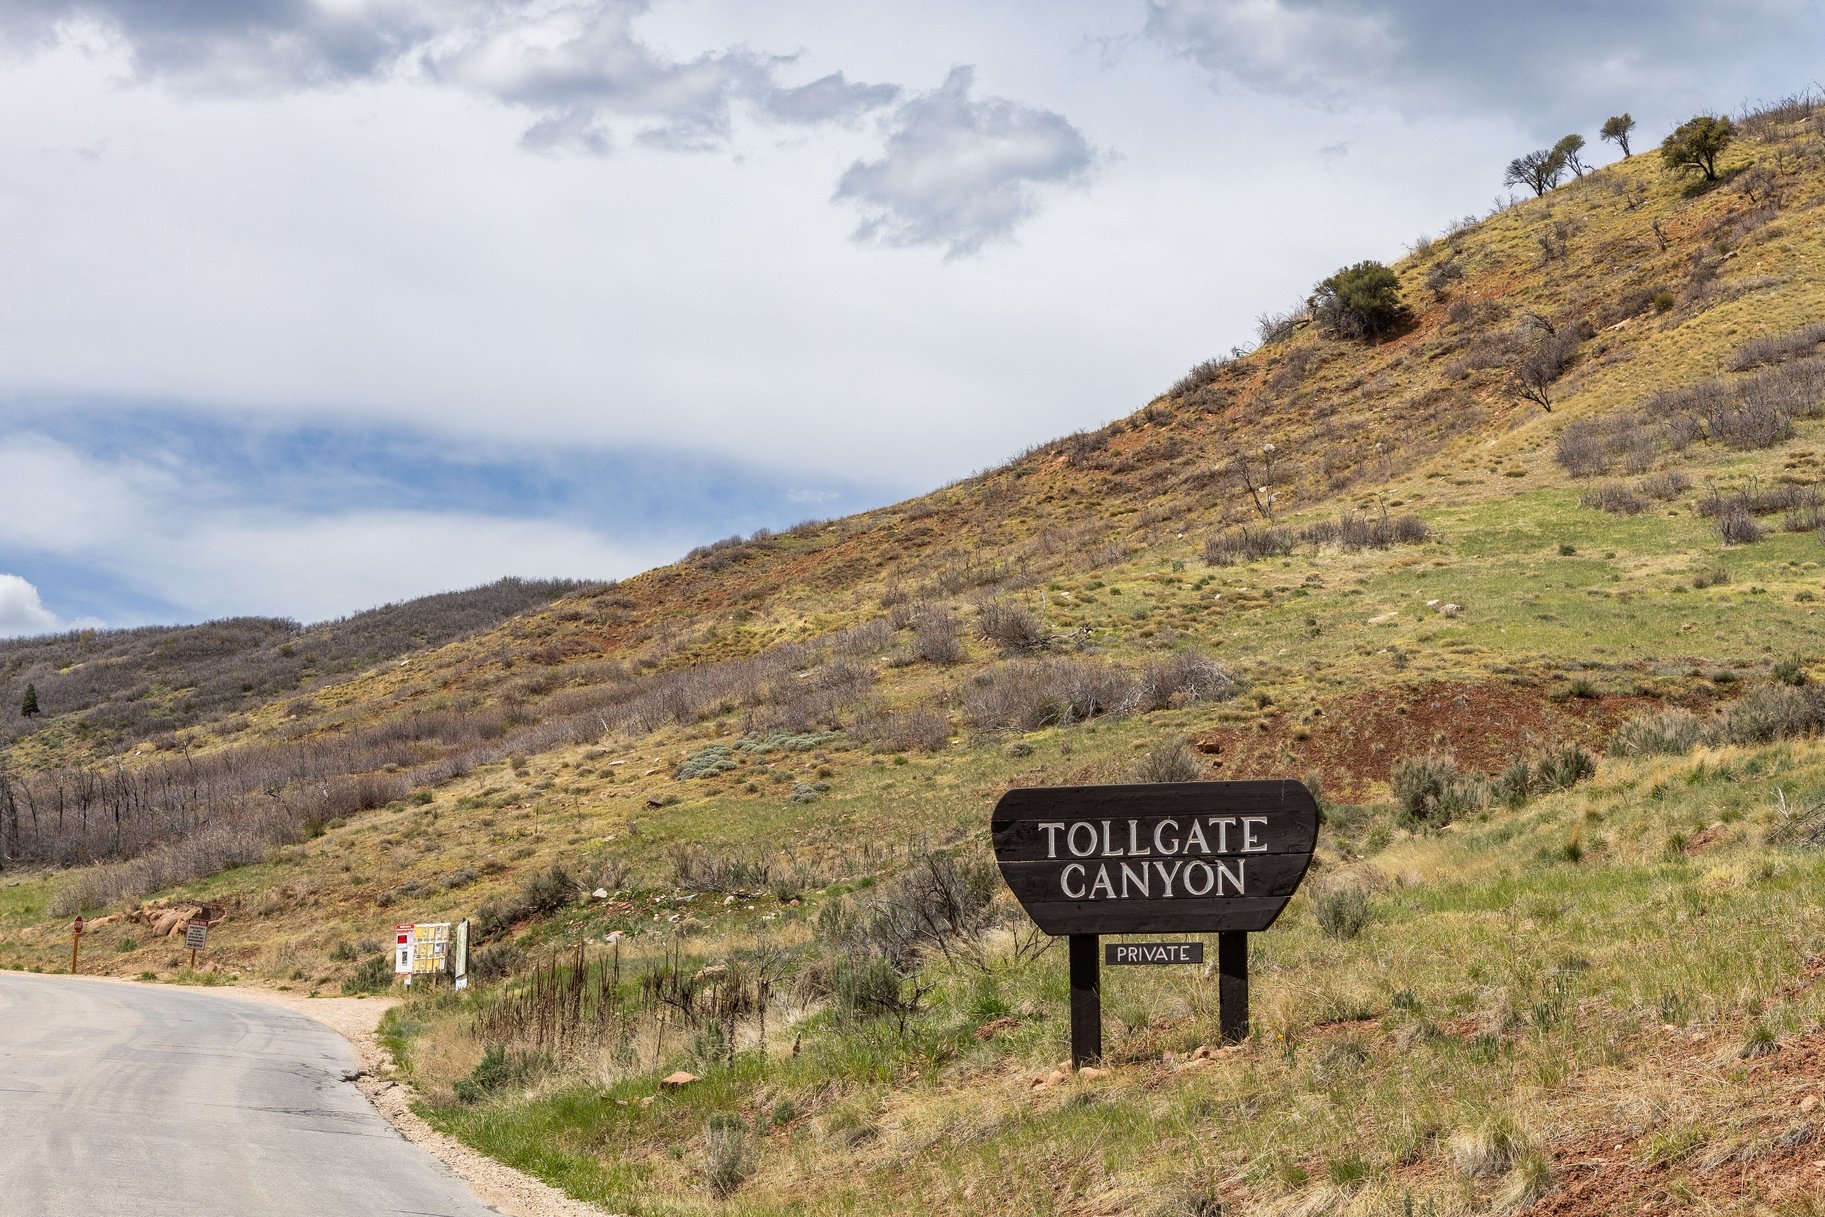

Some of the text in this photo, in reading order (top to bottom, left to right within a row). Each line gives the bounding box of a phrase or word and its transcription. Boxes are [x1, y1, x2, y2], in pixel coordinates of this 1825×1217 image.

[1038, 816, 1268, 858] TOLLGATE
[1060, 859, 1246, 899] CANYON
[1117, 945, 1190, 962] PRIVATE
